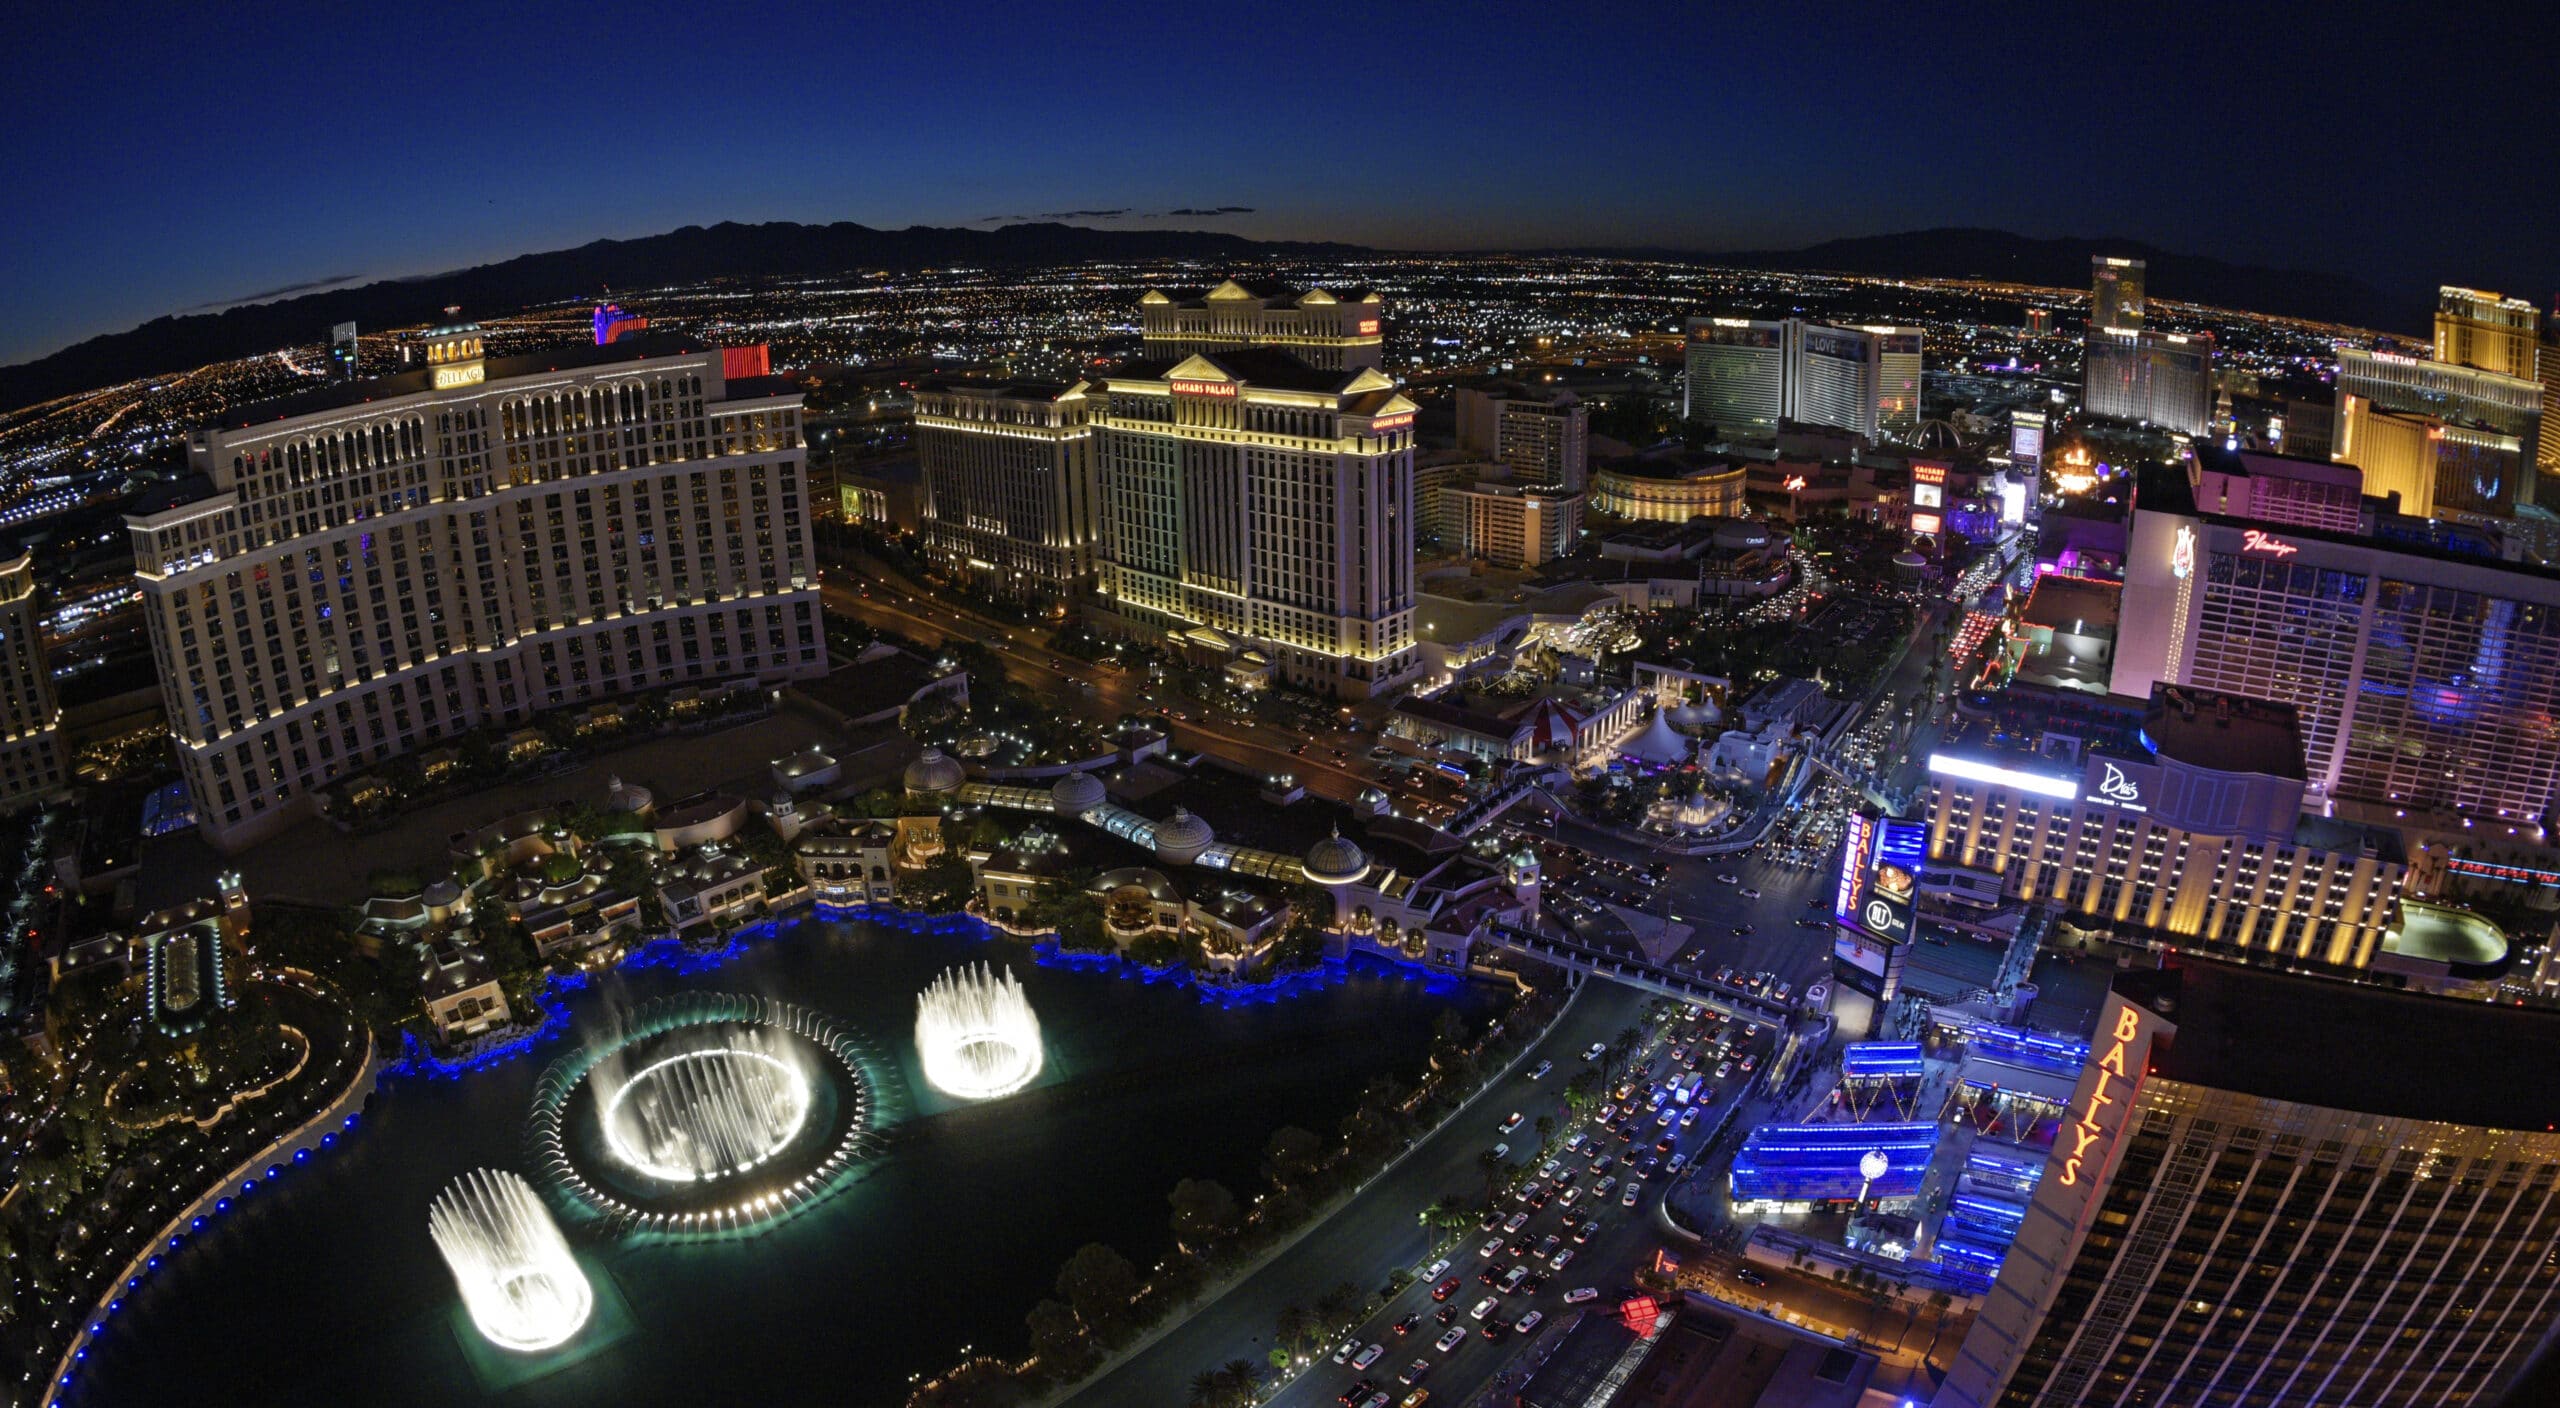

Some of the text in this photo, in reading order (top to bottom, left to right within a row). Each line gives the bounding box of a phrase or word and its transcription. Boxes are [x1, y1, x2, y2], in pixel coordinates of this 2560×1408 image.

[1815, 336, 1836, 353] LOVE
[2371, 351, 2418, 366] VENETIAN
[1172, 382, 1235, 395] CAESARS PALACE
[1372, 418, 1394, 429] CAESARS
[1914, 465, 1945, 475] CAESARS
[1915, 473, 1943, 483] PALACE
[2243, 529, 2298, 558] Flamingo
[1871, 905, 1888, 925] BLT
